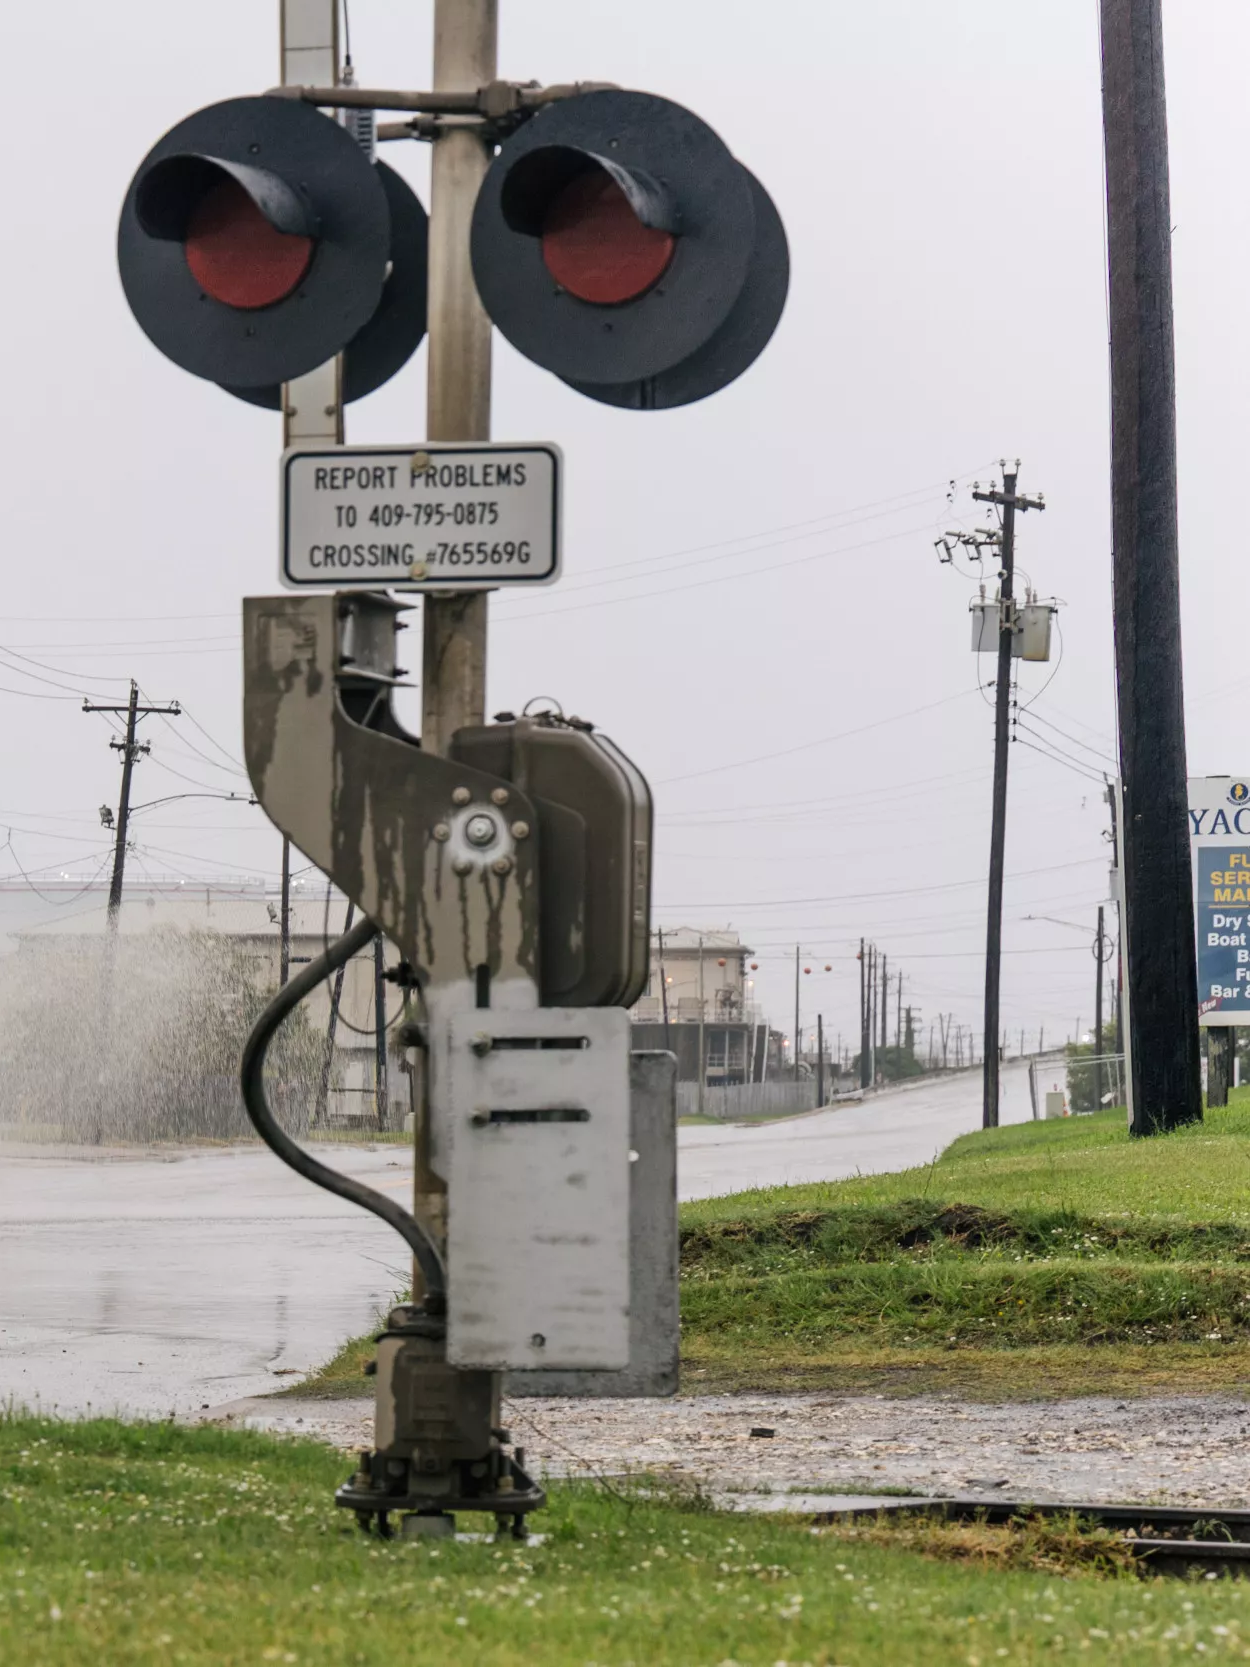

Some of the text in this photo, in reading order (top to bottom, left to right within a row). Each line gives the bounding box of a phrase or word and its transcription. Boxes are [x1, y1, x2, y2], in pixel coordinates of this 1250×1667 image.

[315, 463, 527, 491] REPORT PROBLEMS
[335, 501, 499, 528] TO 409-795-0875
[309, 540, 531, 568] CROSSING #765569G
[1214, 888, 1250, 902] MA
[1213, 914, 1242, 931] Dry
[1207, 932, 1246, 946] Boat
[1211, 984, 1240, 998] Bar
